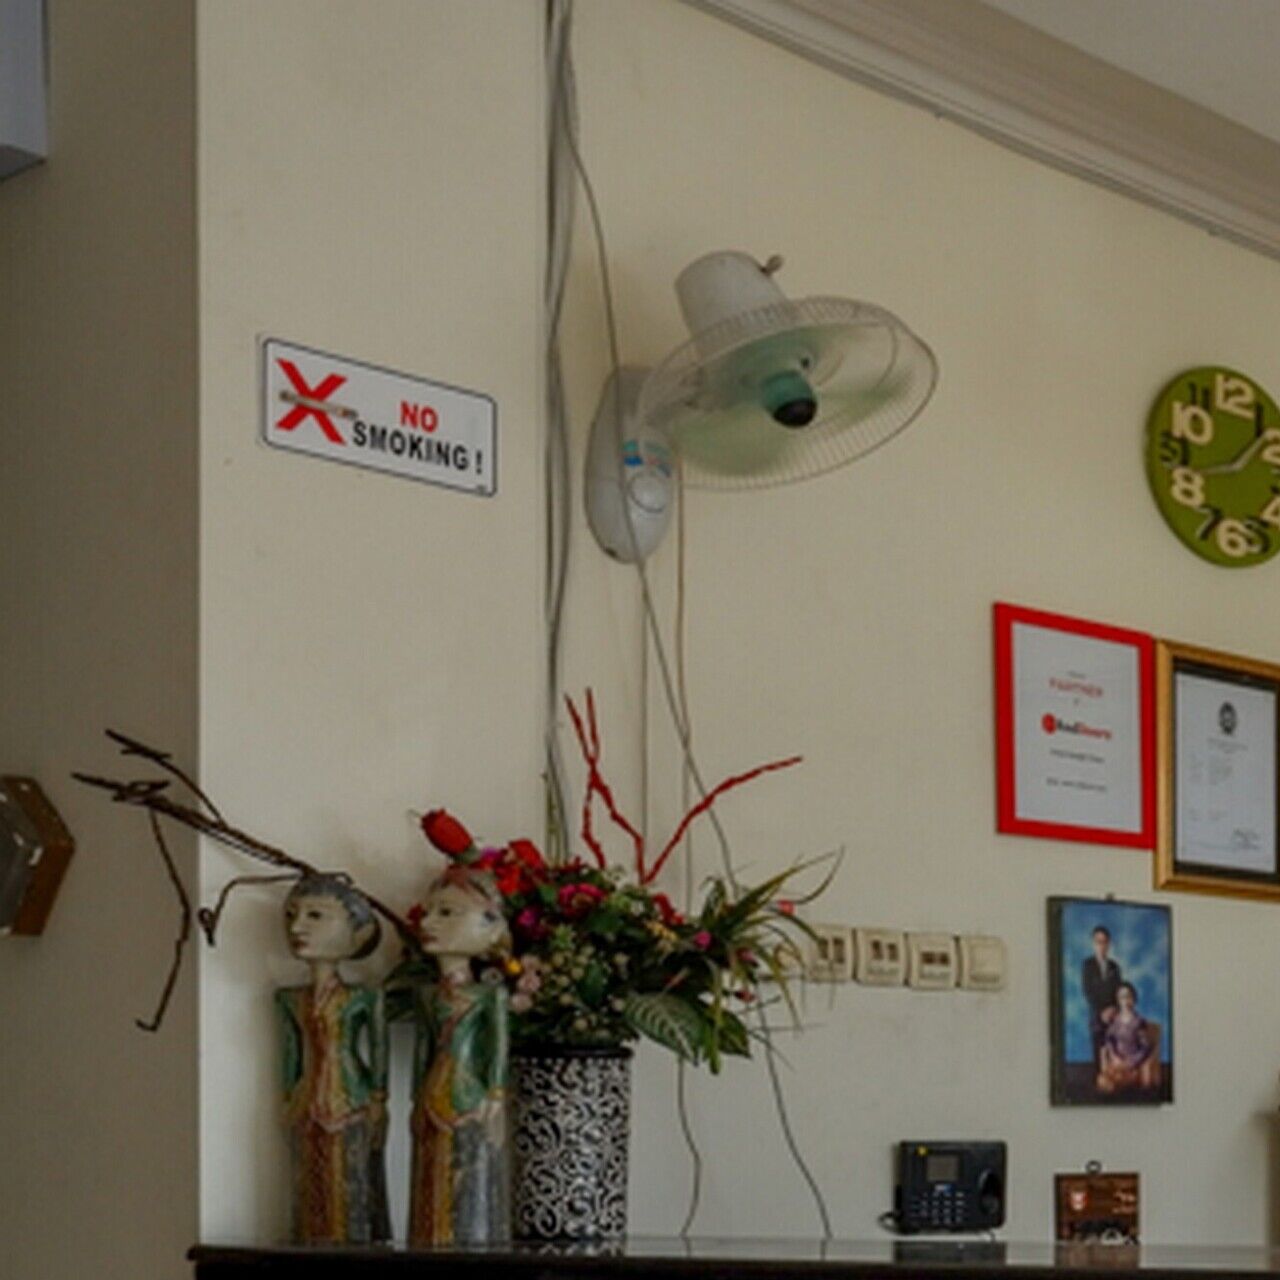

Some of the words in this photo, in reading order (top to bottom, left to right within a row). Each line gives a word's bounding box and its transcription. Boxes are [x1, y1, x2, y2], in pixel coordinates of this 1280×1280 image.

[401, 401, 438, 433] NO
[1215, 373, 1255, 420] 12
[1172, 402, 1214, 445] 10
[353, 421, 468, 471] SMOKING
[1171, 468, 1205, 508] 8
[1217, 518, 1248, 558] 6
